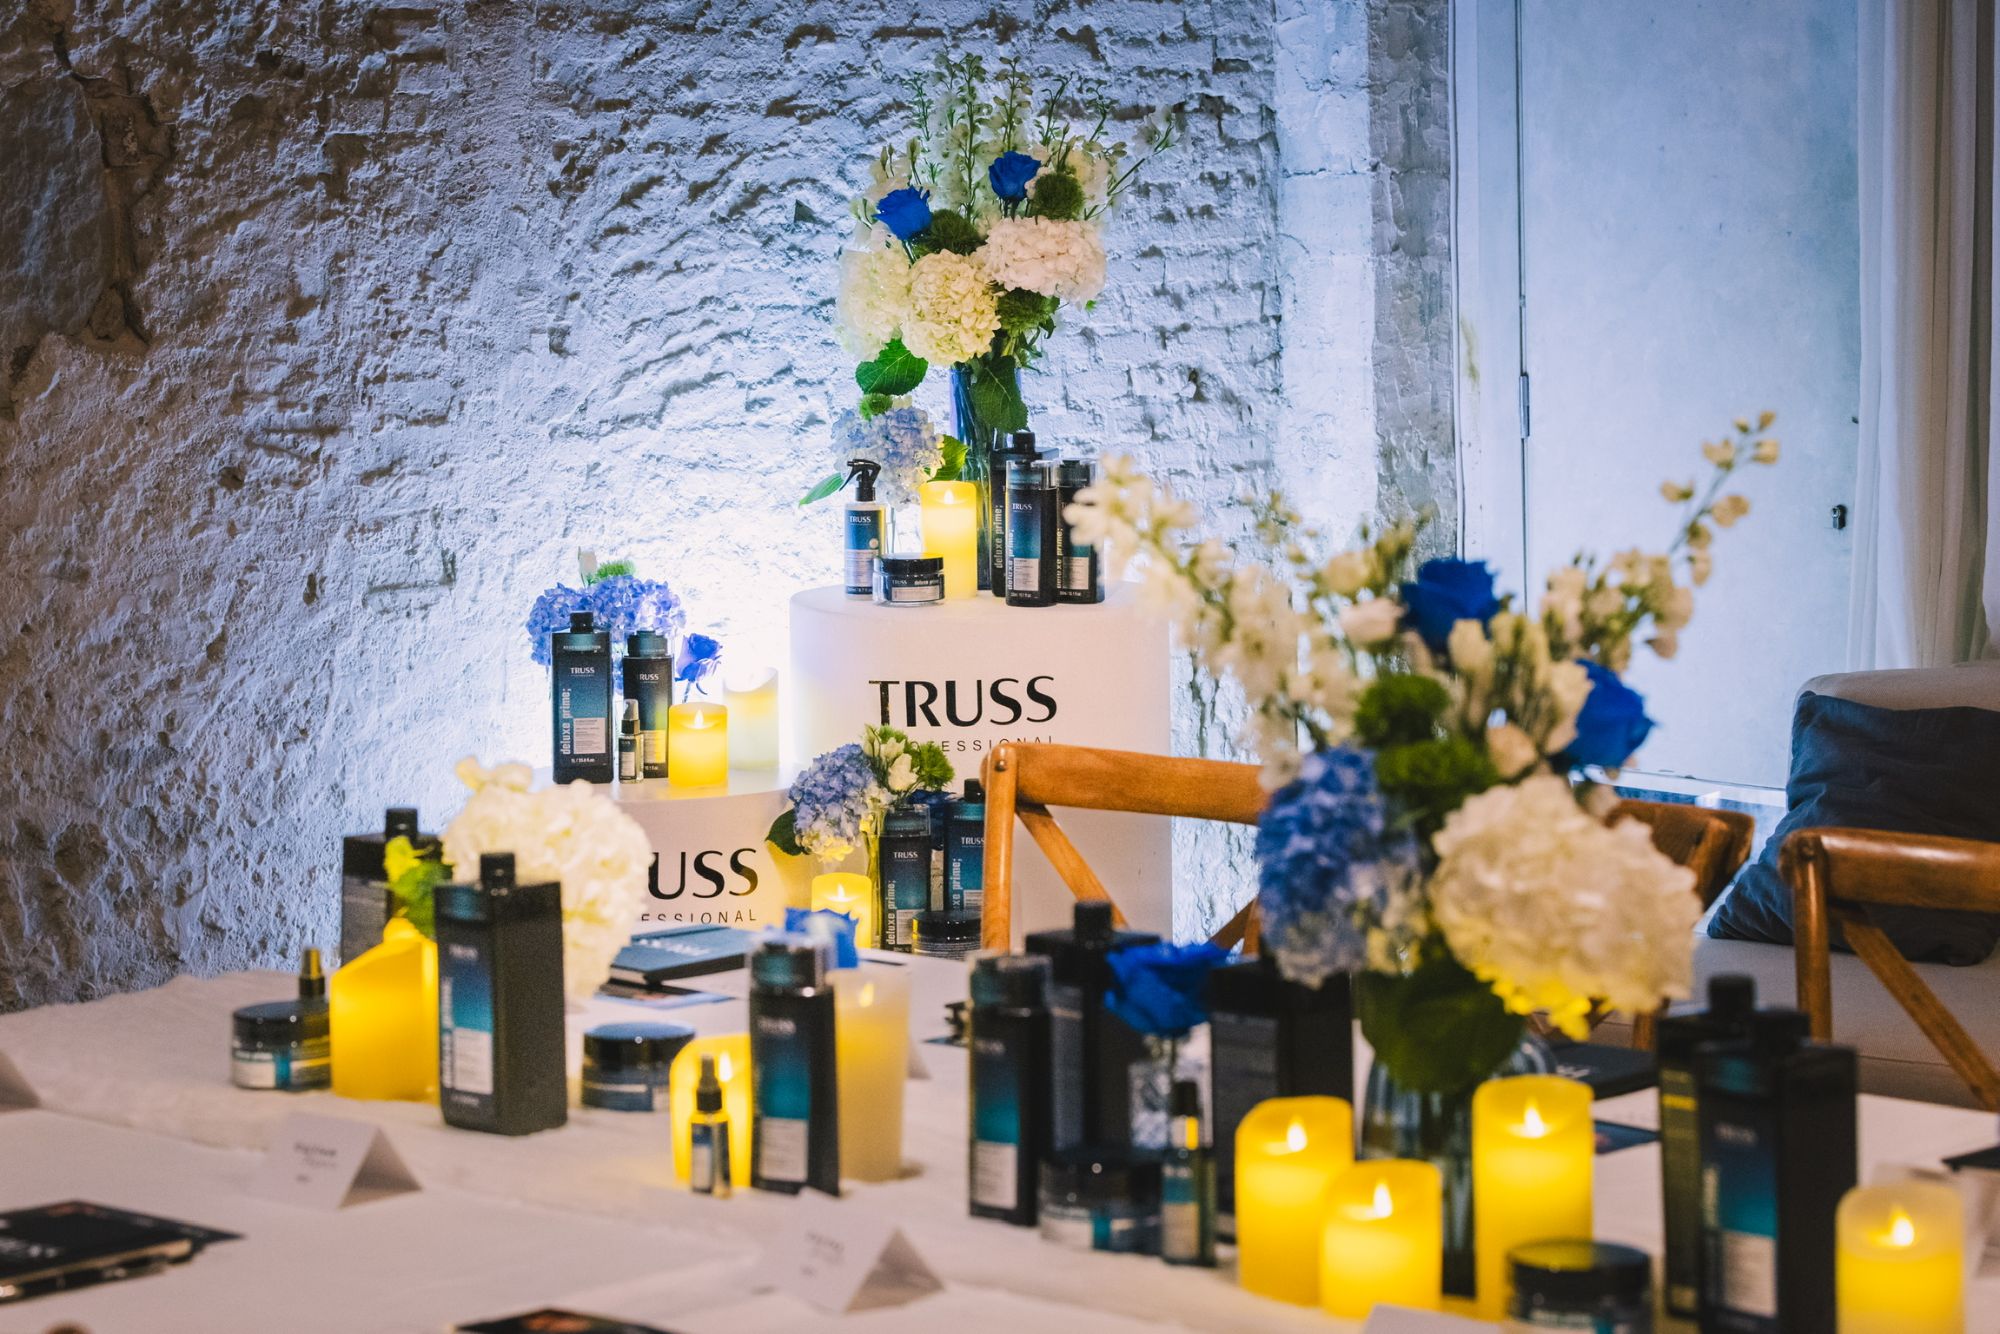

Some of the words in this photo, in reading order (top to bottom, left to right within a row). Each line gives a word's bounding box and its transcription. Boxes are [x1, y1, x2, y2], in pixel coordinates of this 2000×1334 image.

[639, 673, 660, 681] RUSS
[562, 688, 573, 719] prime;
[869, 676, 1057, 727] TRUSS
[560, 722, 570, 755] deluxe
[893, 851, 918, 859] TRUSS
[648, 848, 758, 900] USS
[951, 858, 963, 890] prime;
[888, 880, 897, 910] prime;
[641, 909, 757, 924] ESSIONAL
[886, 913, 895, 945] deluxe
